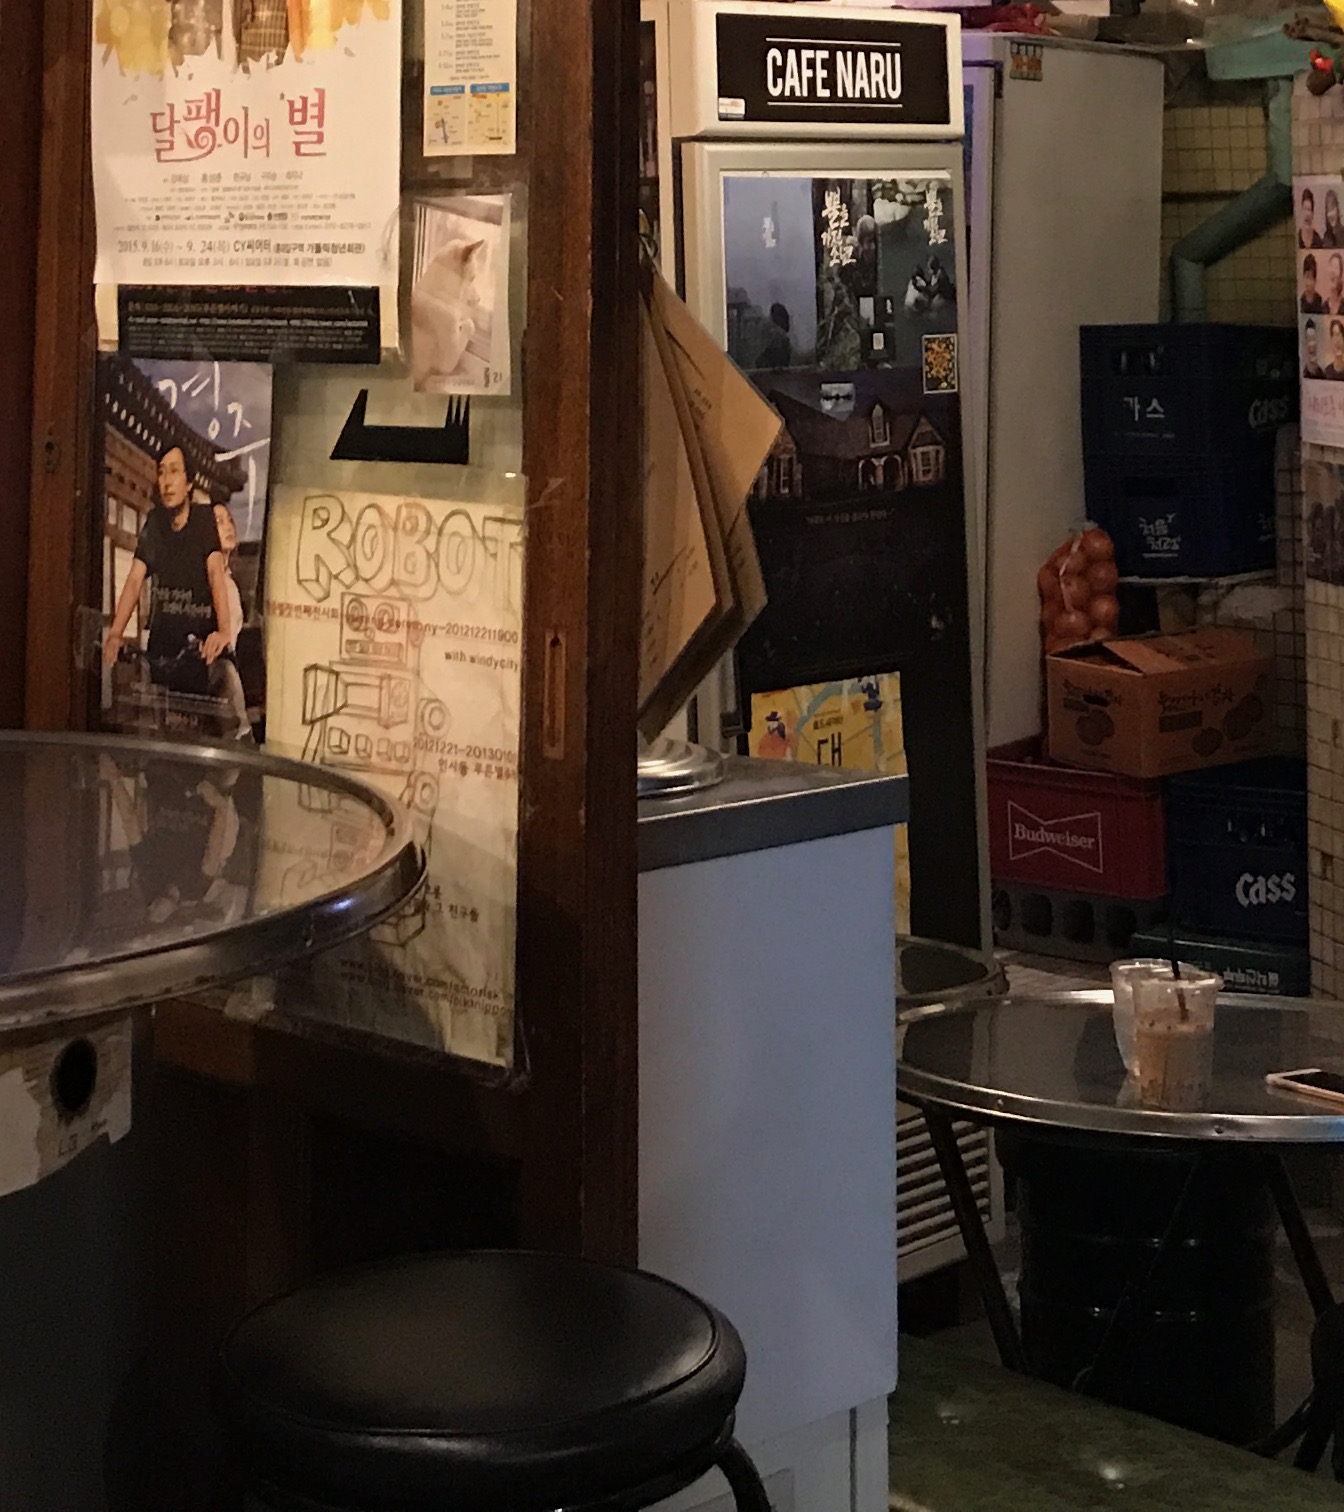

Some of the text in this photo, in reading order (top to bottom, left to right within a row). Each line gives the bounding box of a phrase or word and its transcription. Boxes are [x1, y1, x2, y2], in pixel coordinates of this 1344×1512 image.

[766, 47, 902, 99] CAFE NARU
[150, 88, 327, 163] 달팽이의 별
[1013, 823, 1096, 850] Budweiser
[1235, 873, 1297, 908] Cass
